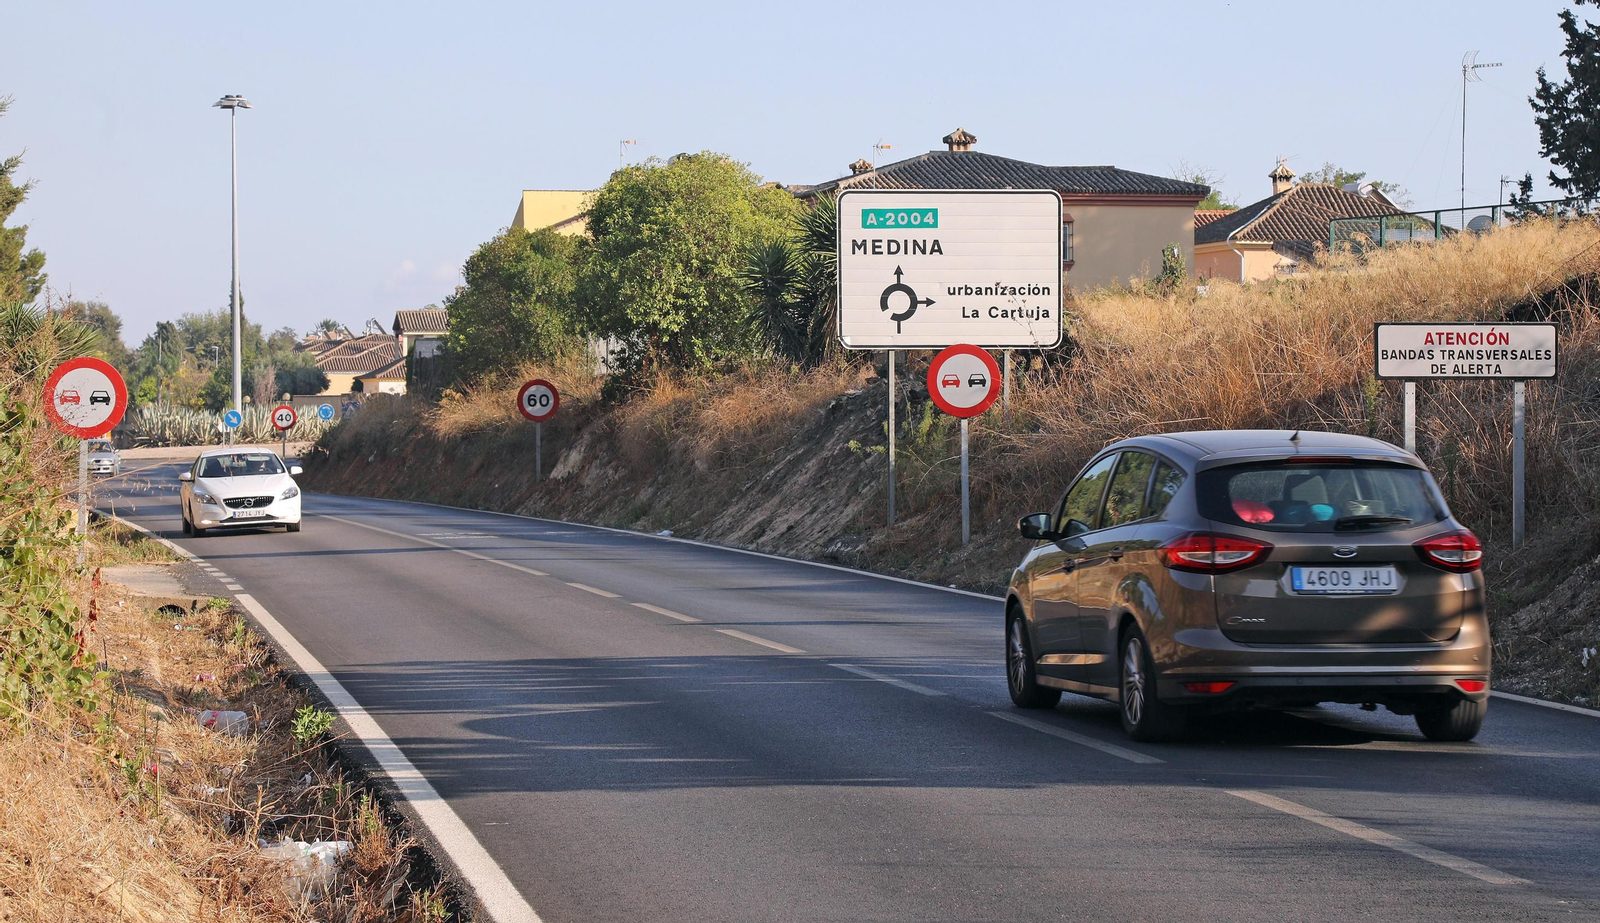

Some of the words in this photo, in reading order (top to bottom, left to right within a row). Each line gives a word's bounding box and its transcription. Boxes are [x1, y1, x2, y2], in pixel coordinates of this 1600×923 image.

[865, 211, 935, 225] A-2004
[852, 239, 943, 255] MEDINA
[947, 283, 1051, 296] urbanización
[962, 306, 980, 319] La
[988, 306, 1051, 322] Cartuja
[1424, 327, 1510, 345] ATENCIÓN
[1381, 349, 1434, 360] BANDAS
[1440, 349, 1552, 360] TRANSVERSALES
[1431, 364, 1447, 375] DE
[1452, 364, 1502, 375] ALERTA
[527, 394, 550, 407] 60
[277, 413, 292, 422] 40
[1307, 570, 1351, 586] 4609
[1358, 570, 1393, 586] JHJ
